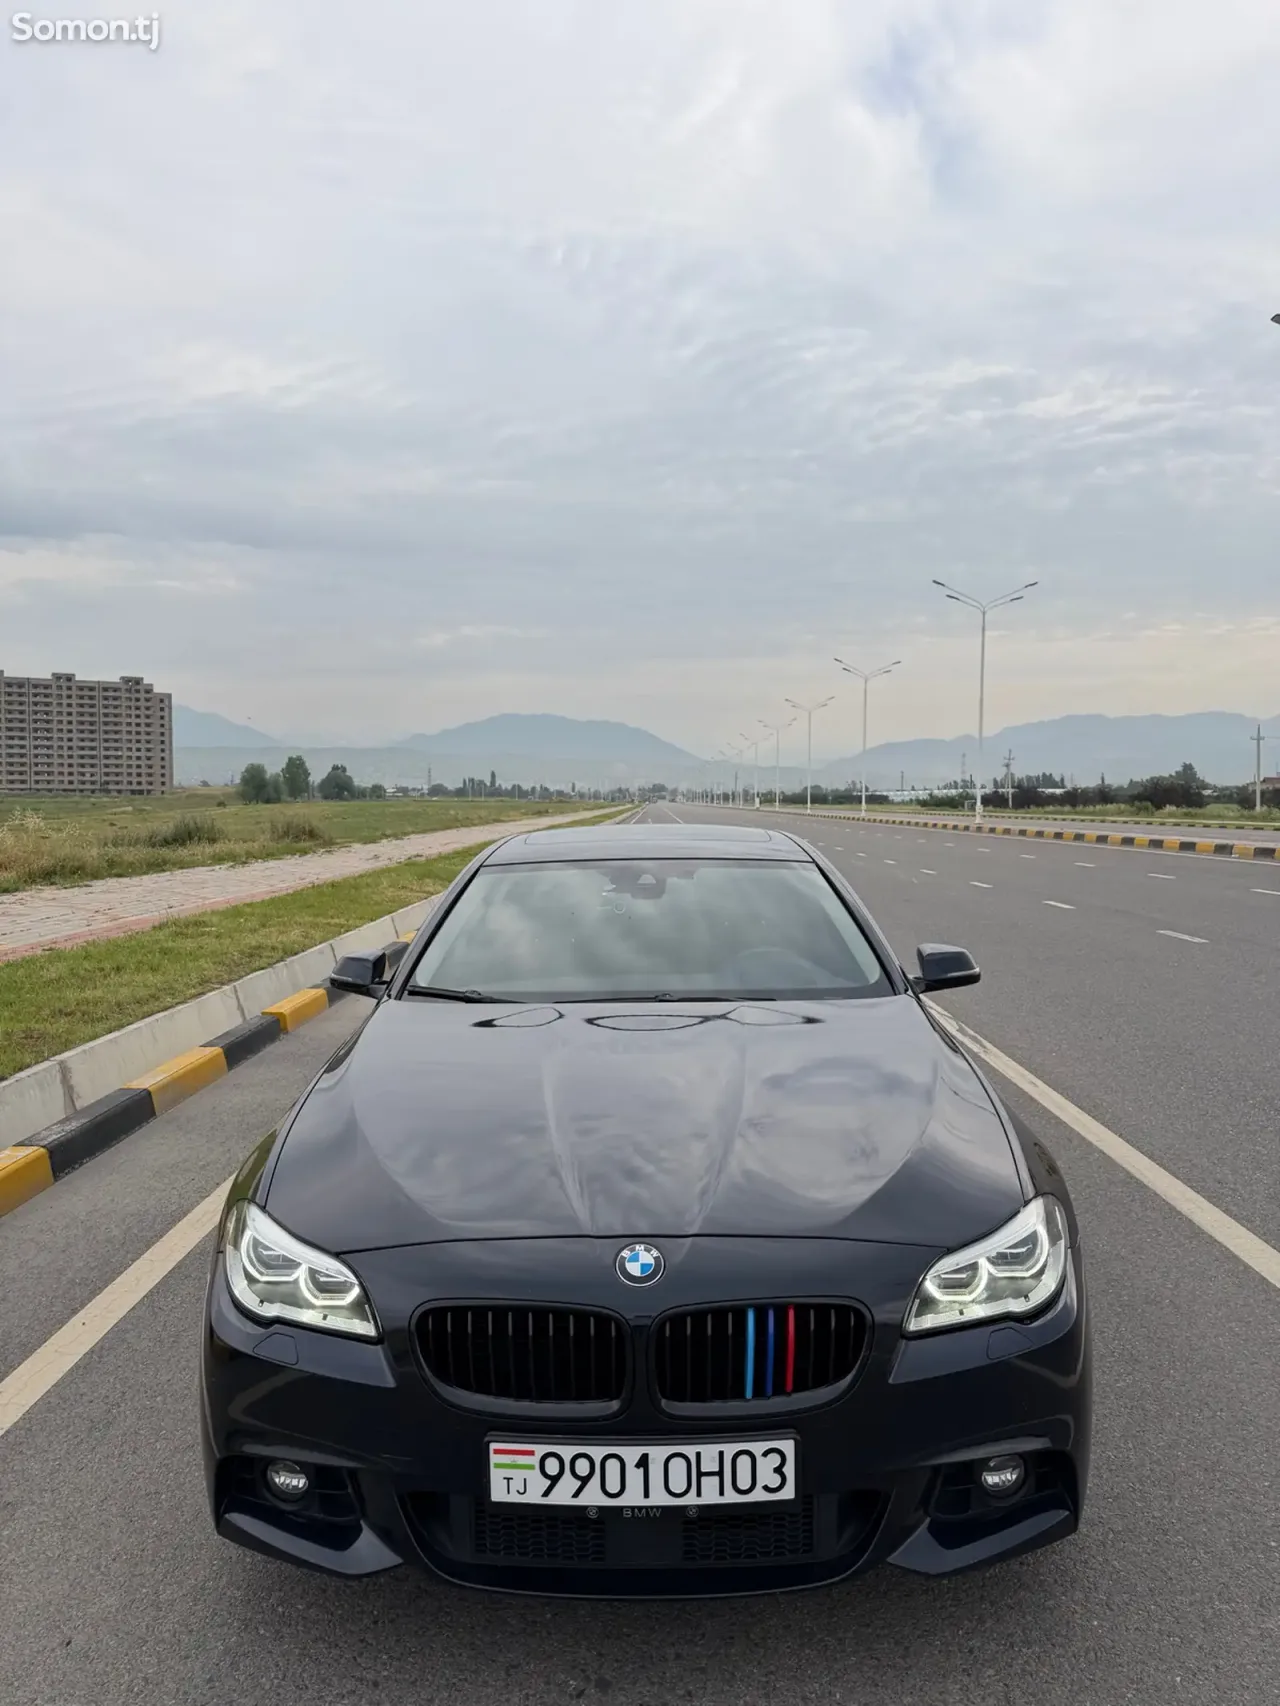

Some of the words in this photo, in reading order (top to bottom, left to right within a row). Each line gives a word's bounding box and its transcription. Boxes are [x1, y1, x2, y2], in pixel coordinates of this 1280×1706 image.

[621, 1244, 660, 1258] BMW
[502, 1476, 528, 1496] TJ
[622, 1507, 662, 1518] BMW
